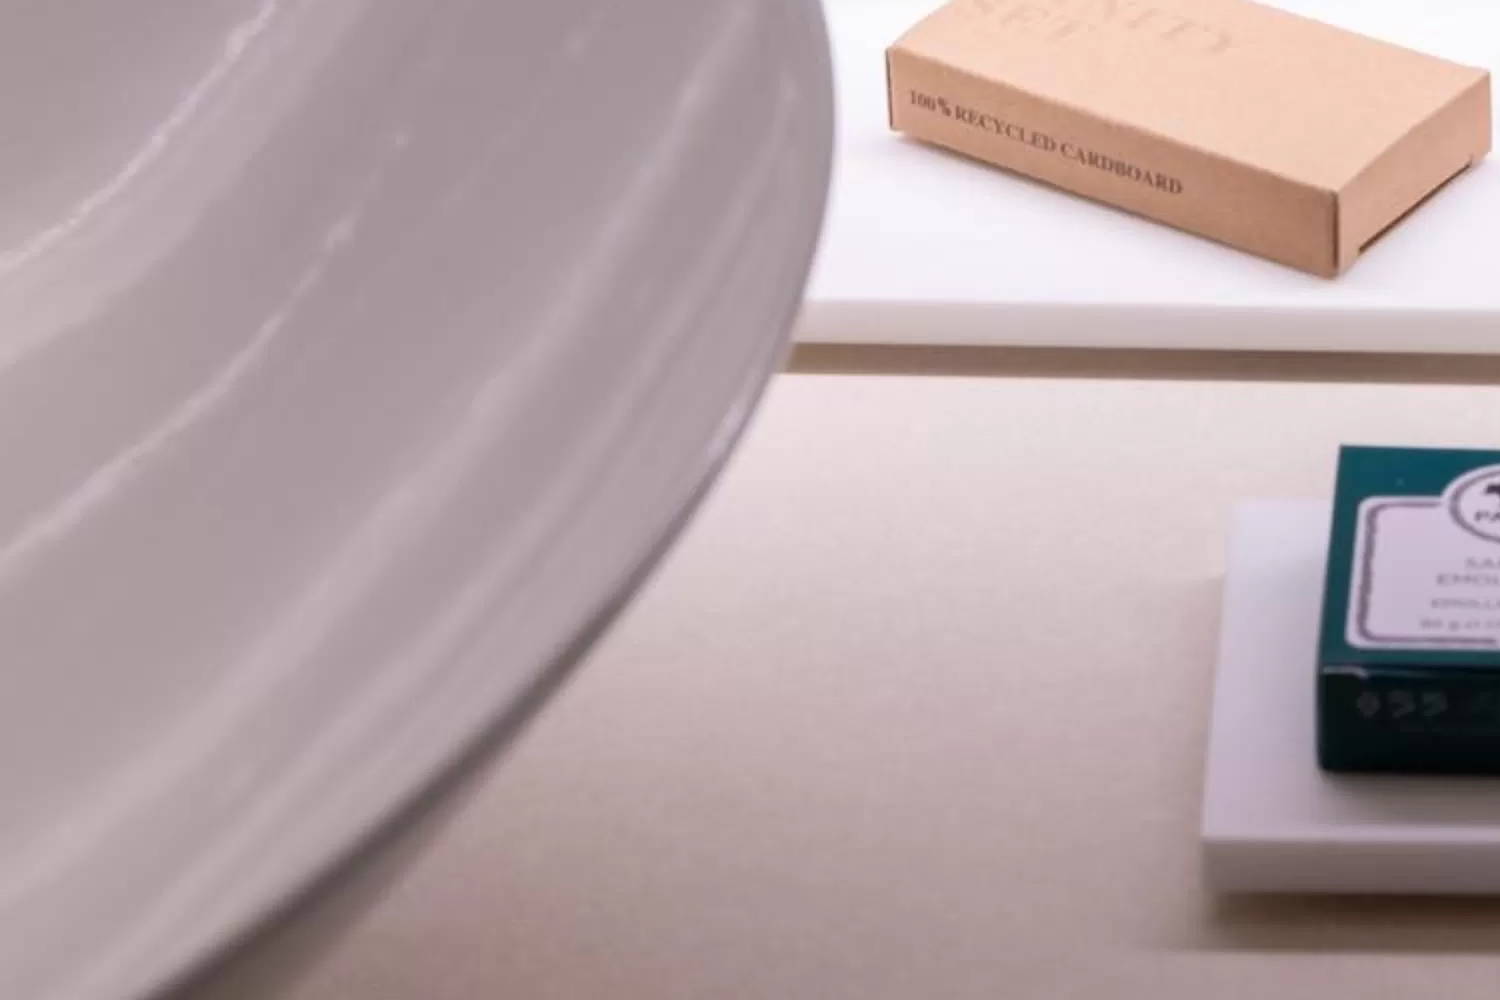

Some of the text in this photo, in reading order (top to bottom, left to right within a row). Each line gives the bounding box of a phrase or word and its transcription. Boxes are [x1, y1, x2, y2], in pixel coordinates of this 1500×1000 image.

[909, 90, 1184, 195] 100% RECYCLED CARDBOARD
